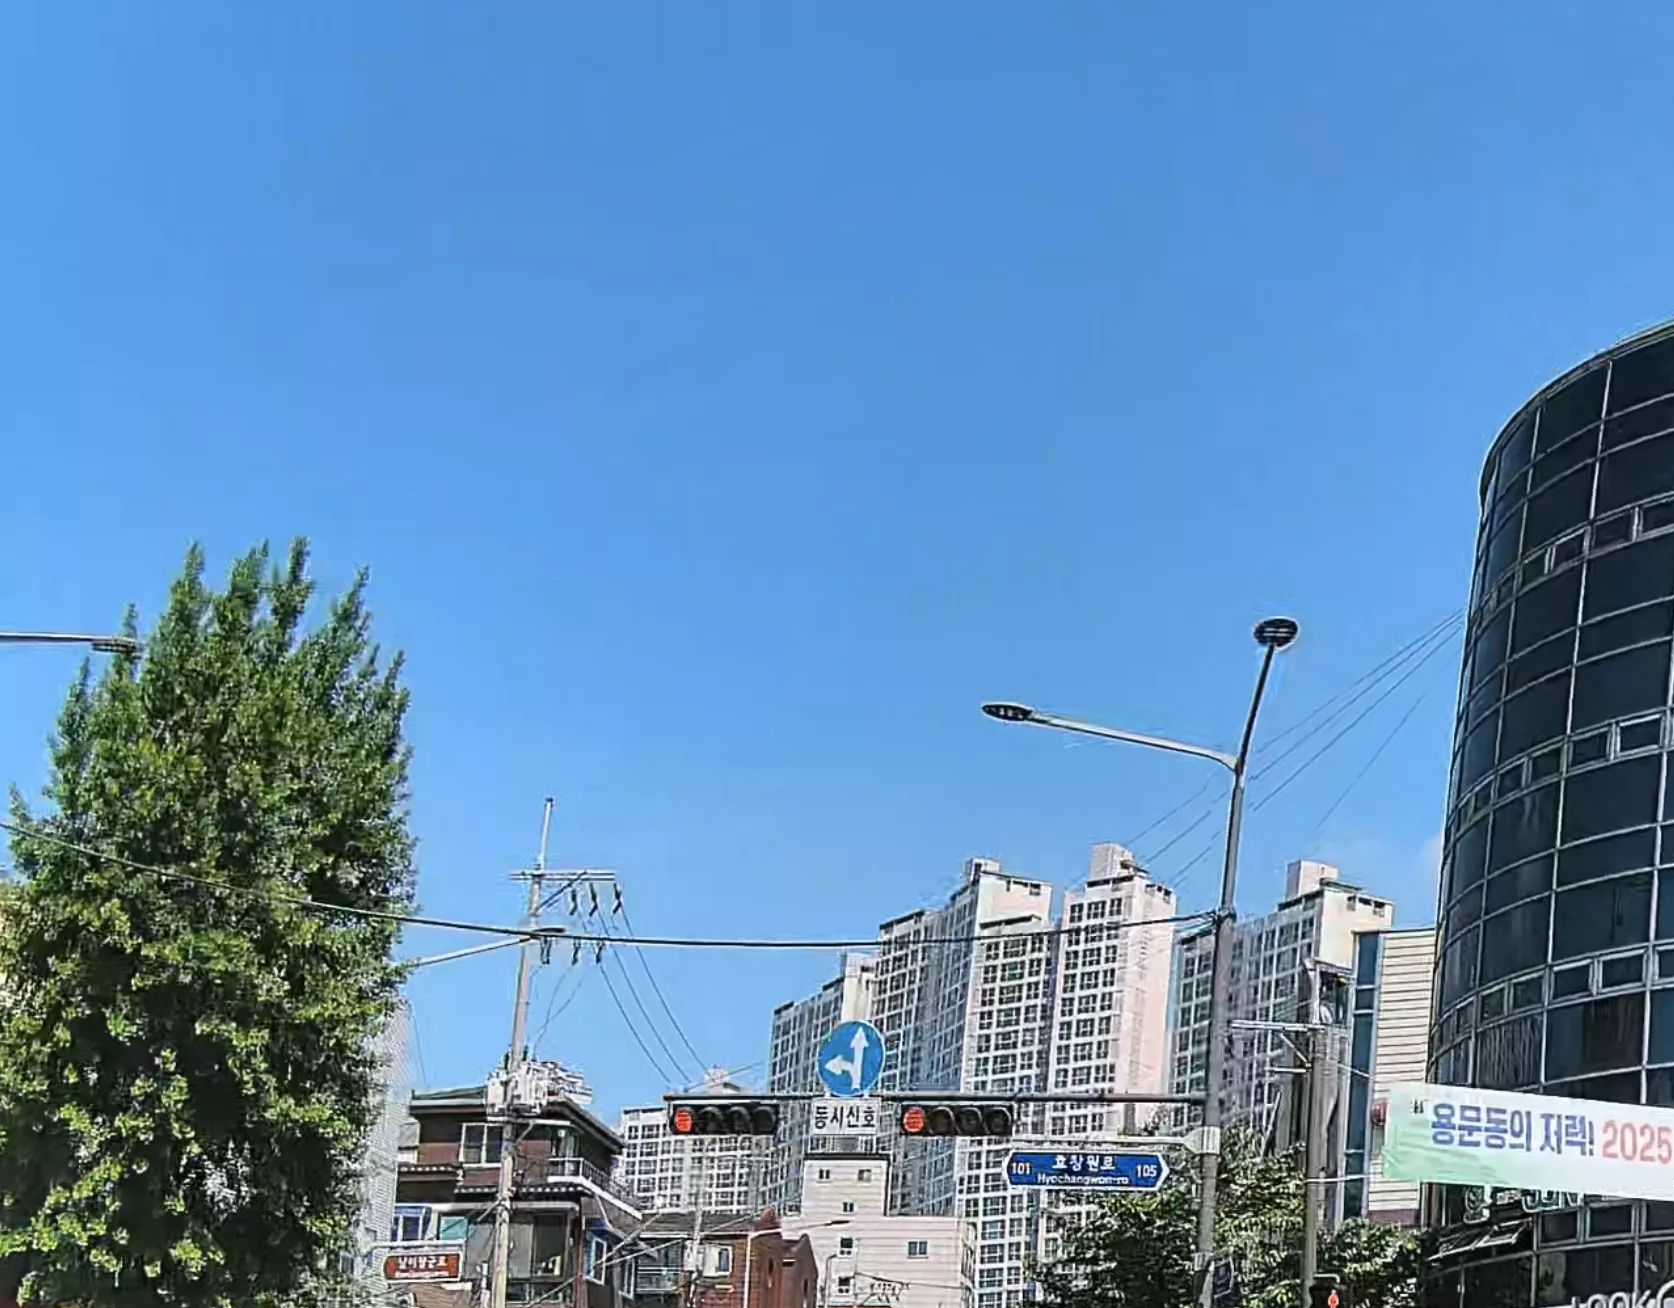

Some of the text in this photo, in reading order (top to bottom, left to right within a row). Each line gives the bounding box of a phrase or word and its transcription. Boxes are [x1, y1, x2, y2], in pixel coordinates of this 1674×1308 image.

[815, 1105, 876, 1129] 동시신호
[1431, 1102, 1533, 1152] 용문동의
[1539, 1112, 1594, 1157] 저력!
[1602, 1118, 1673, 1165] 2025
[1011, 1162, 1030, 1175] 101
[1052, 1155, 1116, 1172] 효창원로
[1136, 1164, 1157, 1178] 105
